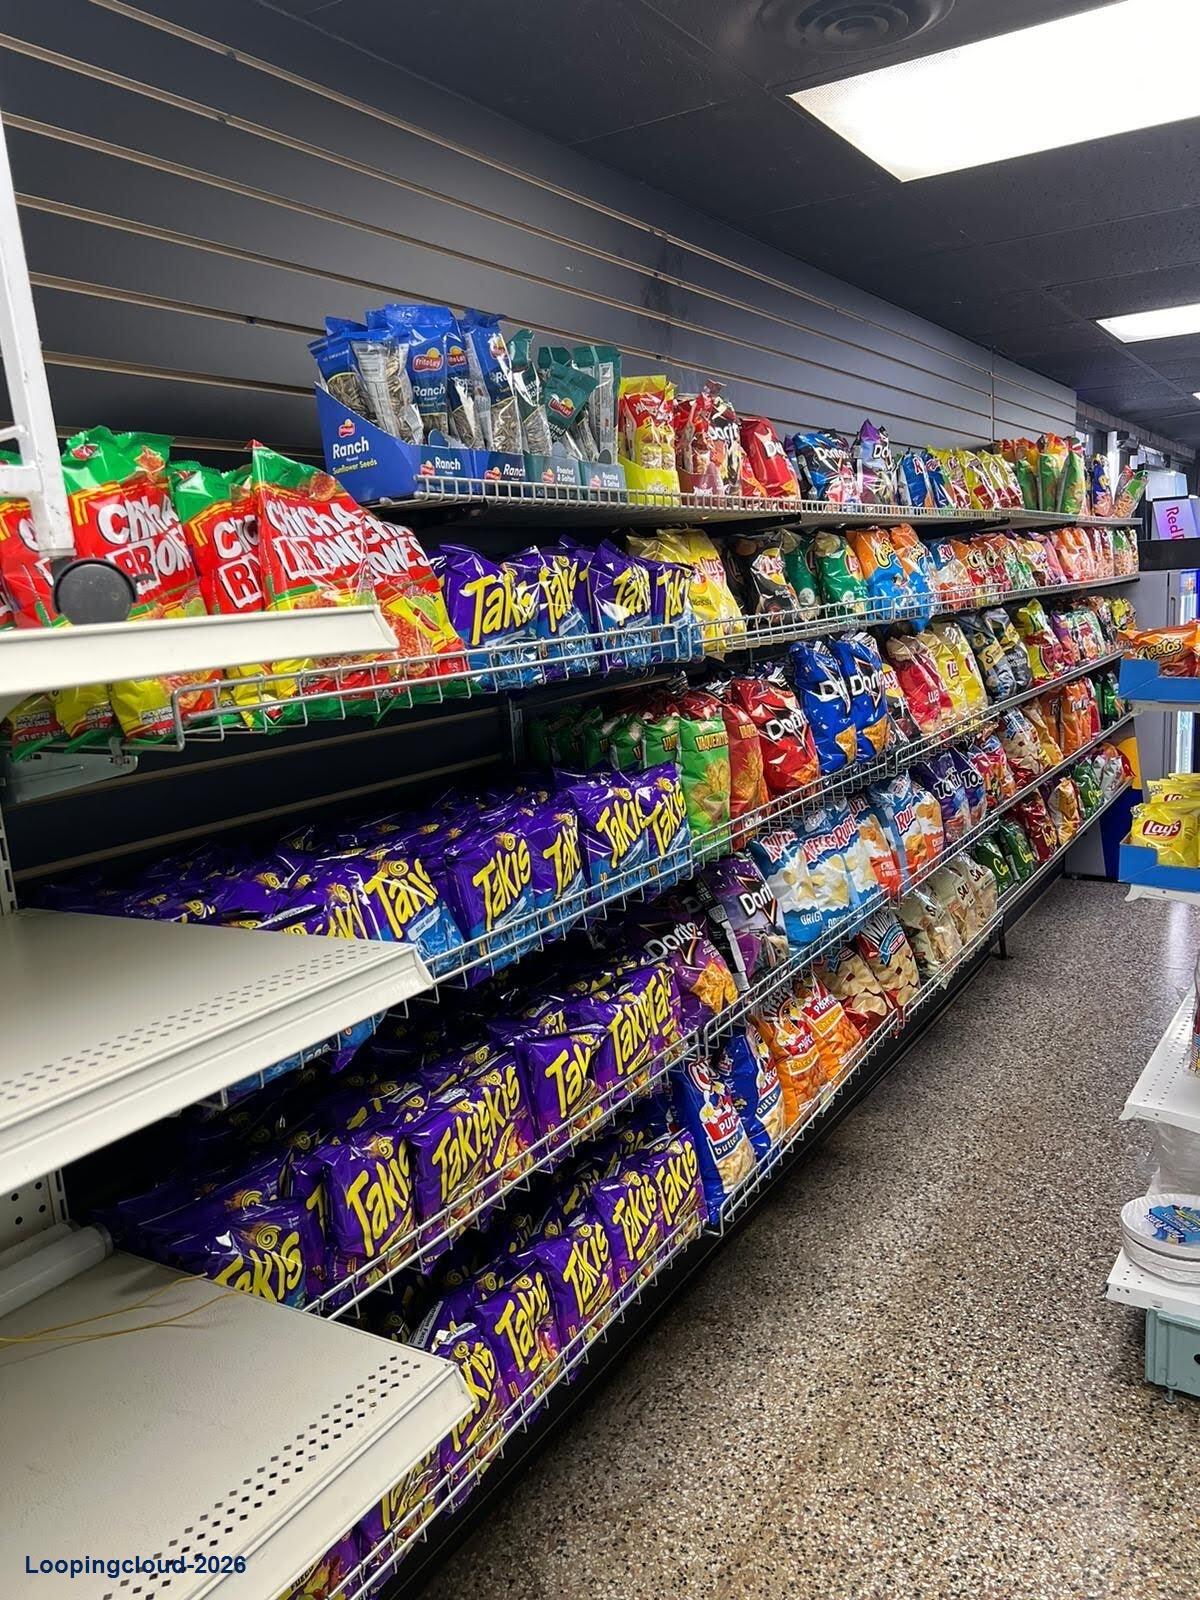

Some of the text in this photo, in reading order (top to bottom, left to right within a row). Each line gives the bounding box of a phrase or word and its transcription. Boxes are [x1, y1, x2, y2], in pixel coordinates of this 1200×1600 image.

[413, 384, 446, 397] Ranch
[333, 437, 369, 459] Ranch
[333, 462, 359, 474] Sunflower
[360, 459, 378, 469] Seeds
[435, 456, 461, 470] Ranch
[641, 781, 687, 857] Takis
[1144, 820, 1180, 836] Lay's
[473, 839, 531, 932] Takis
[613, 1174, 658, 1261] Takis
[655, 1140, 698, 1227] Takis
[562, 1223, 610, 1318] Takis
[495, 1272, 551, 1374] Takis
